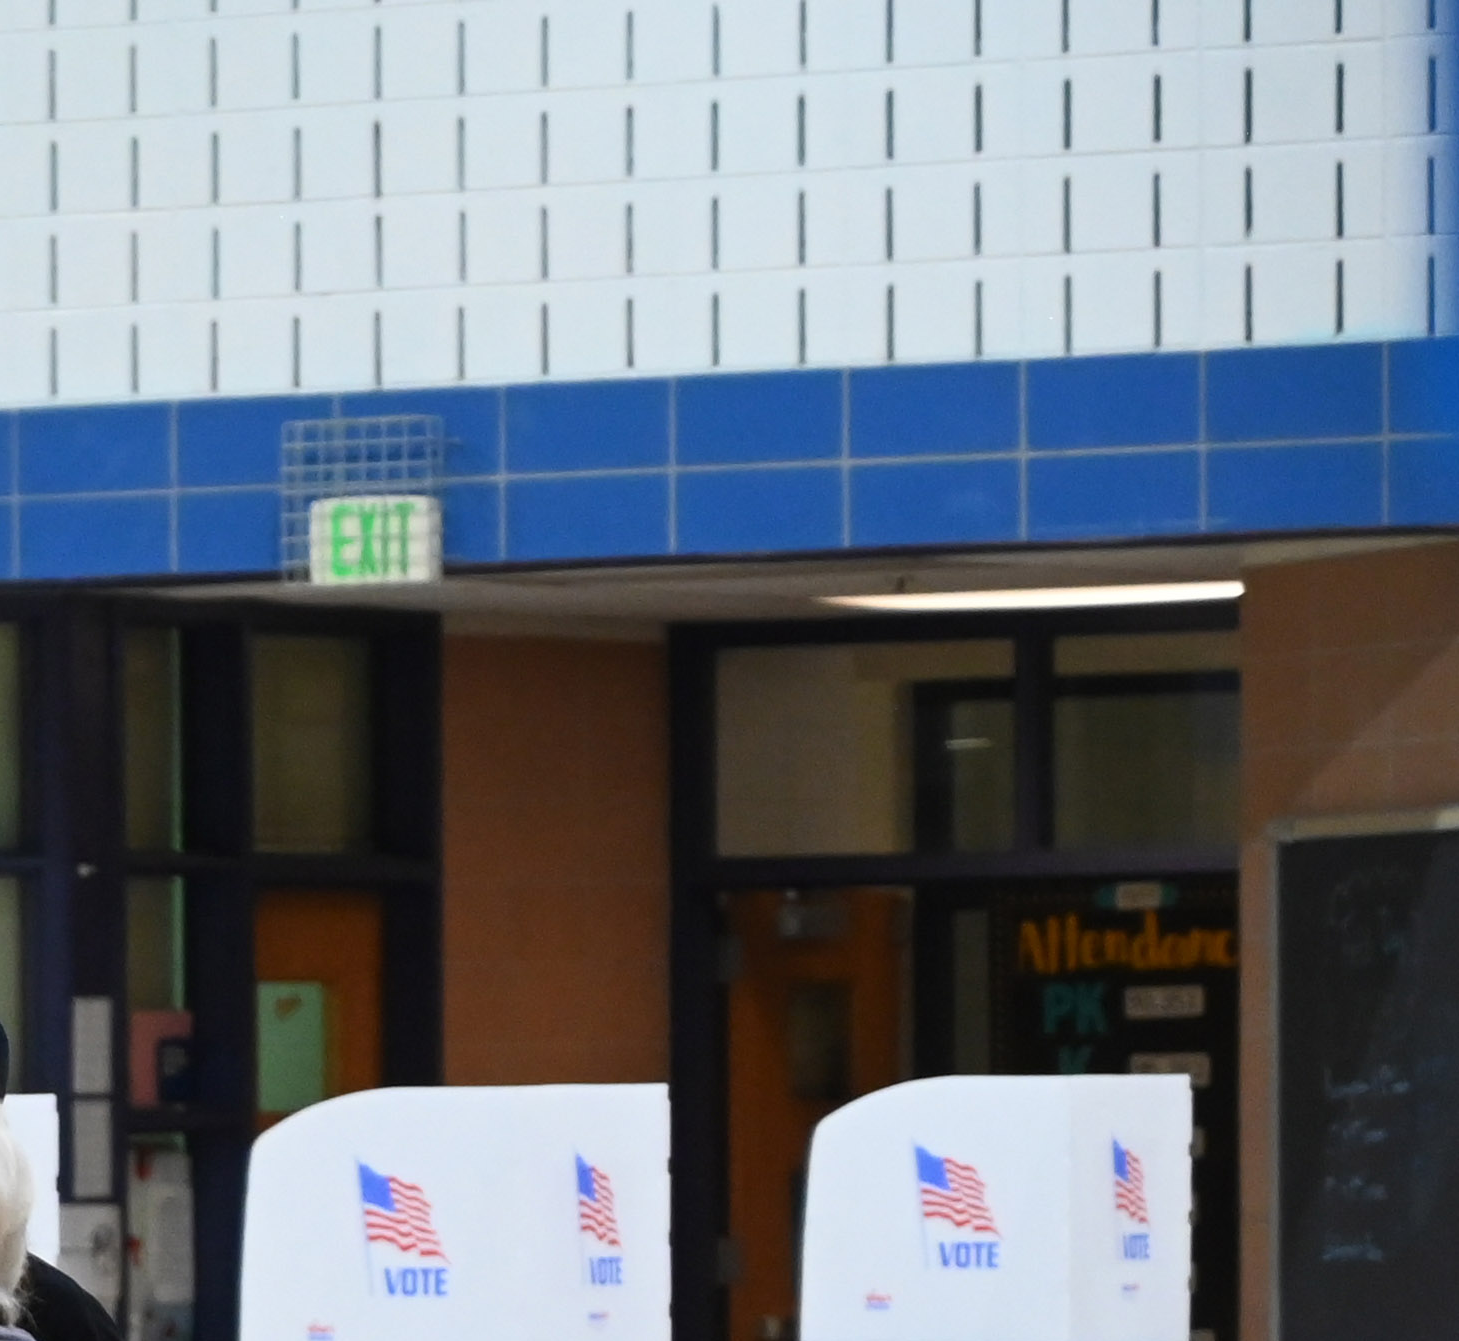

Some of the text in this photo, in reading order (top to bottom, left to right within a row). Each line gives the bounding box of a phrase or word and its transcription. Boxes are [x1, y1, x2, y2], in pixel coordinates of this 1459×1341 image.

[329, 501, 415, 579] EXIT
[1043, 982, 1107, 1035] PK
[938, 1240, 1000, 1270] VOTE
[1122, 1232, 1151, 1260] VOTE
[383, 1266, 449, 1297] VOTE
[589, 1256, 623, 1286] VOTE
